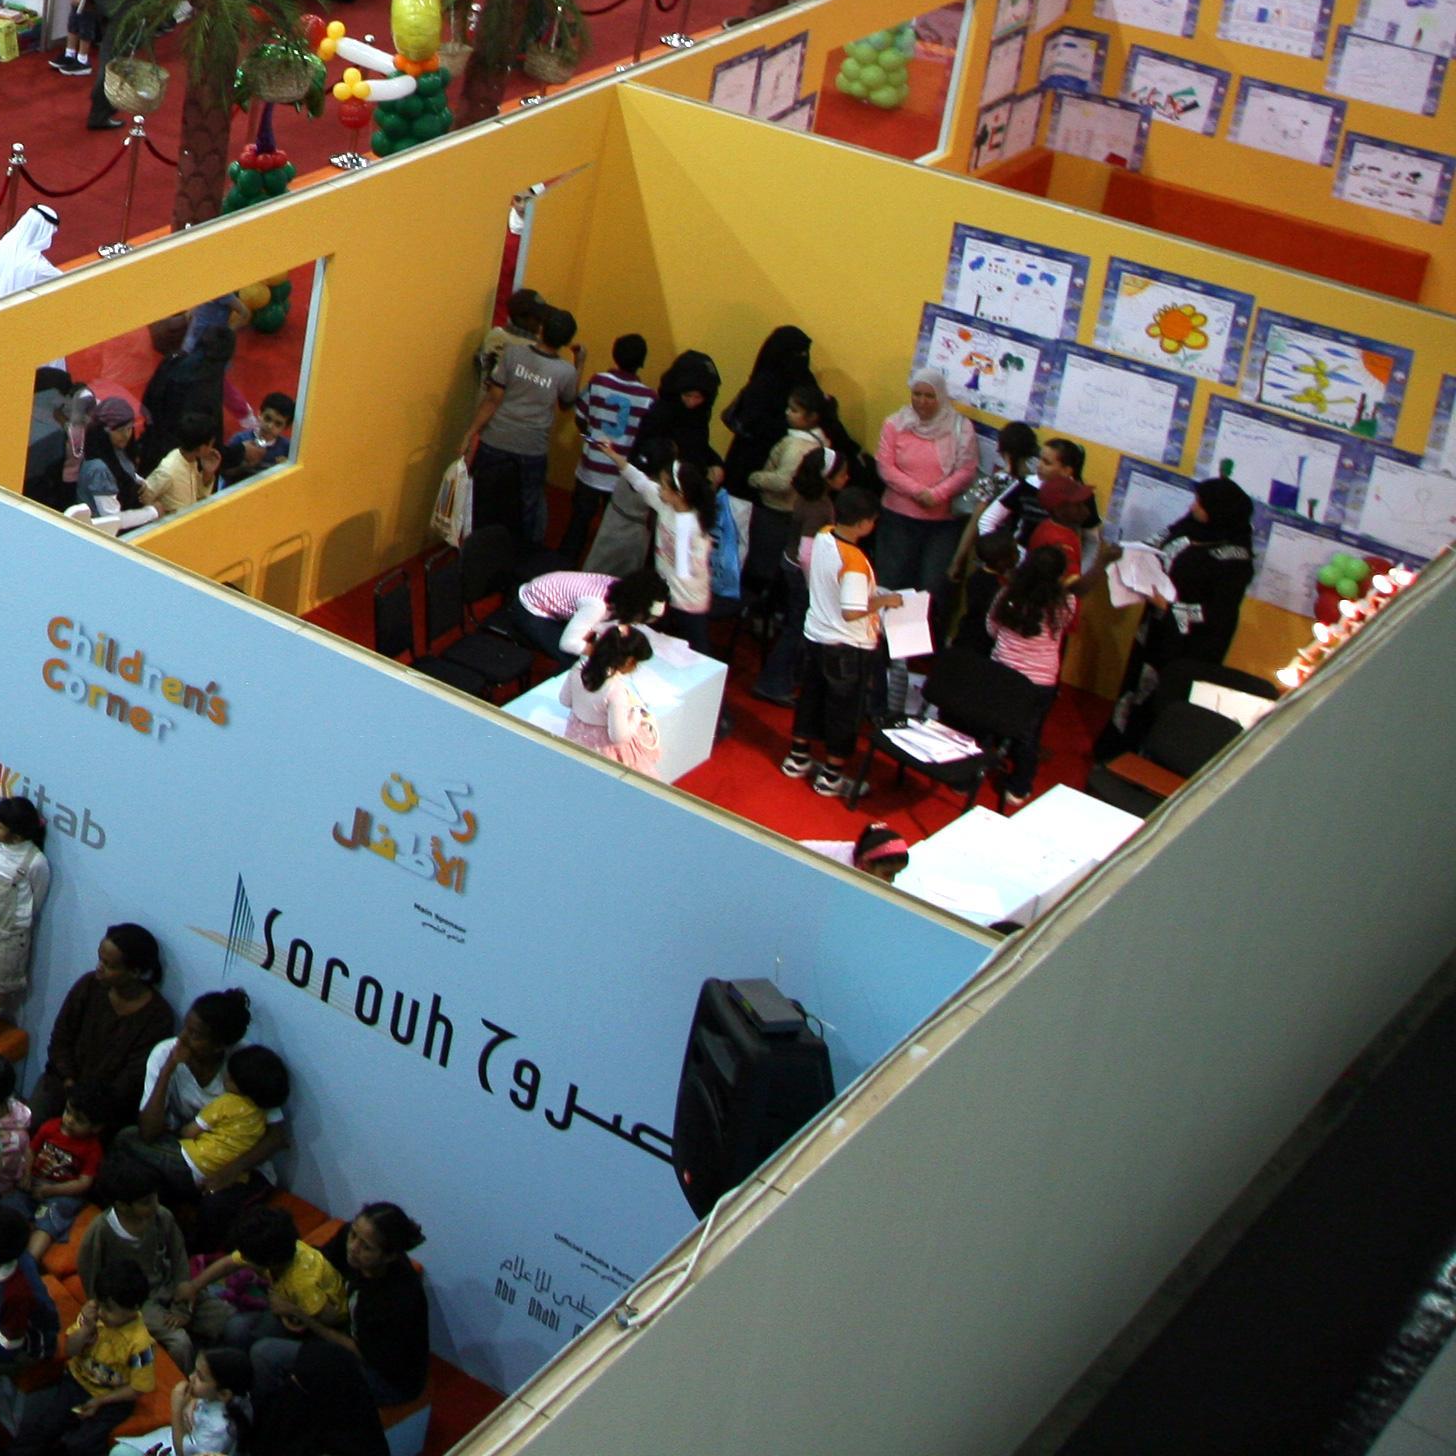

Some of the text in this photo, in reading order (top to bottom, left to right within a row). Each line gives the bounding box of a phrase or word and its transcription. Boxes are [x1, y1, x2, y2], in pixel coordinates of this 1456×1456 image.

[42, 657, 173, 741] Corner
[46, 614, 230, 727] Children's
[380, 771, 477, 844] ركن
[331, 806, 468, 895] الأطفال
[413, 901, 467, 934] Main Sponsor
[259, 907, 455, 1069] Sorouh
[554, 1232, 610, 1270] Official Media
